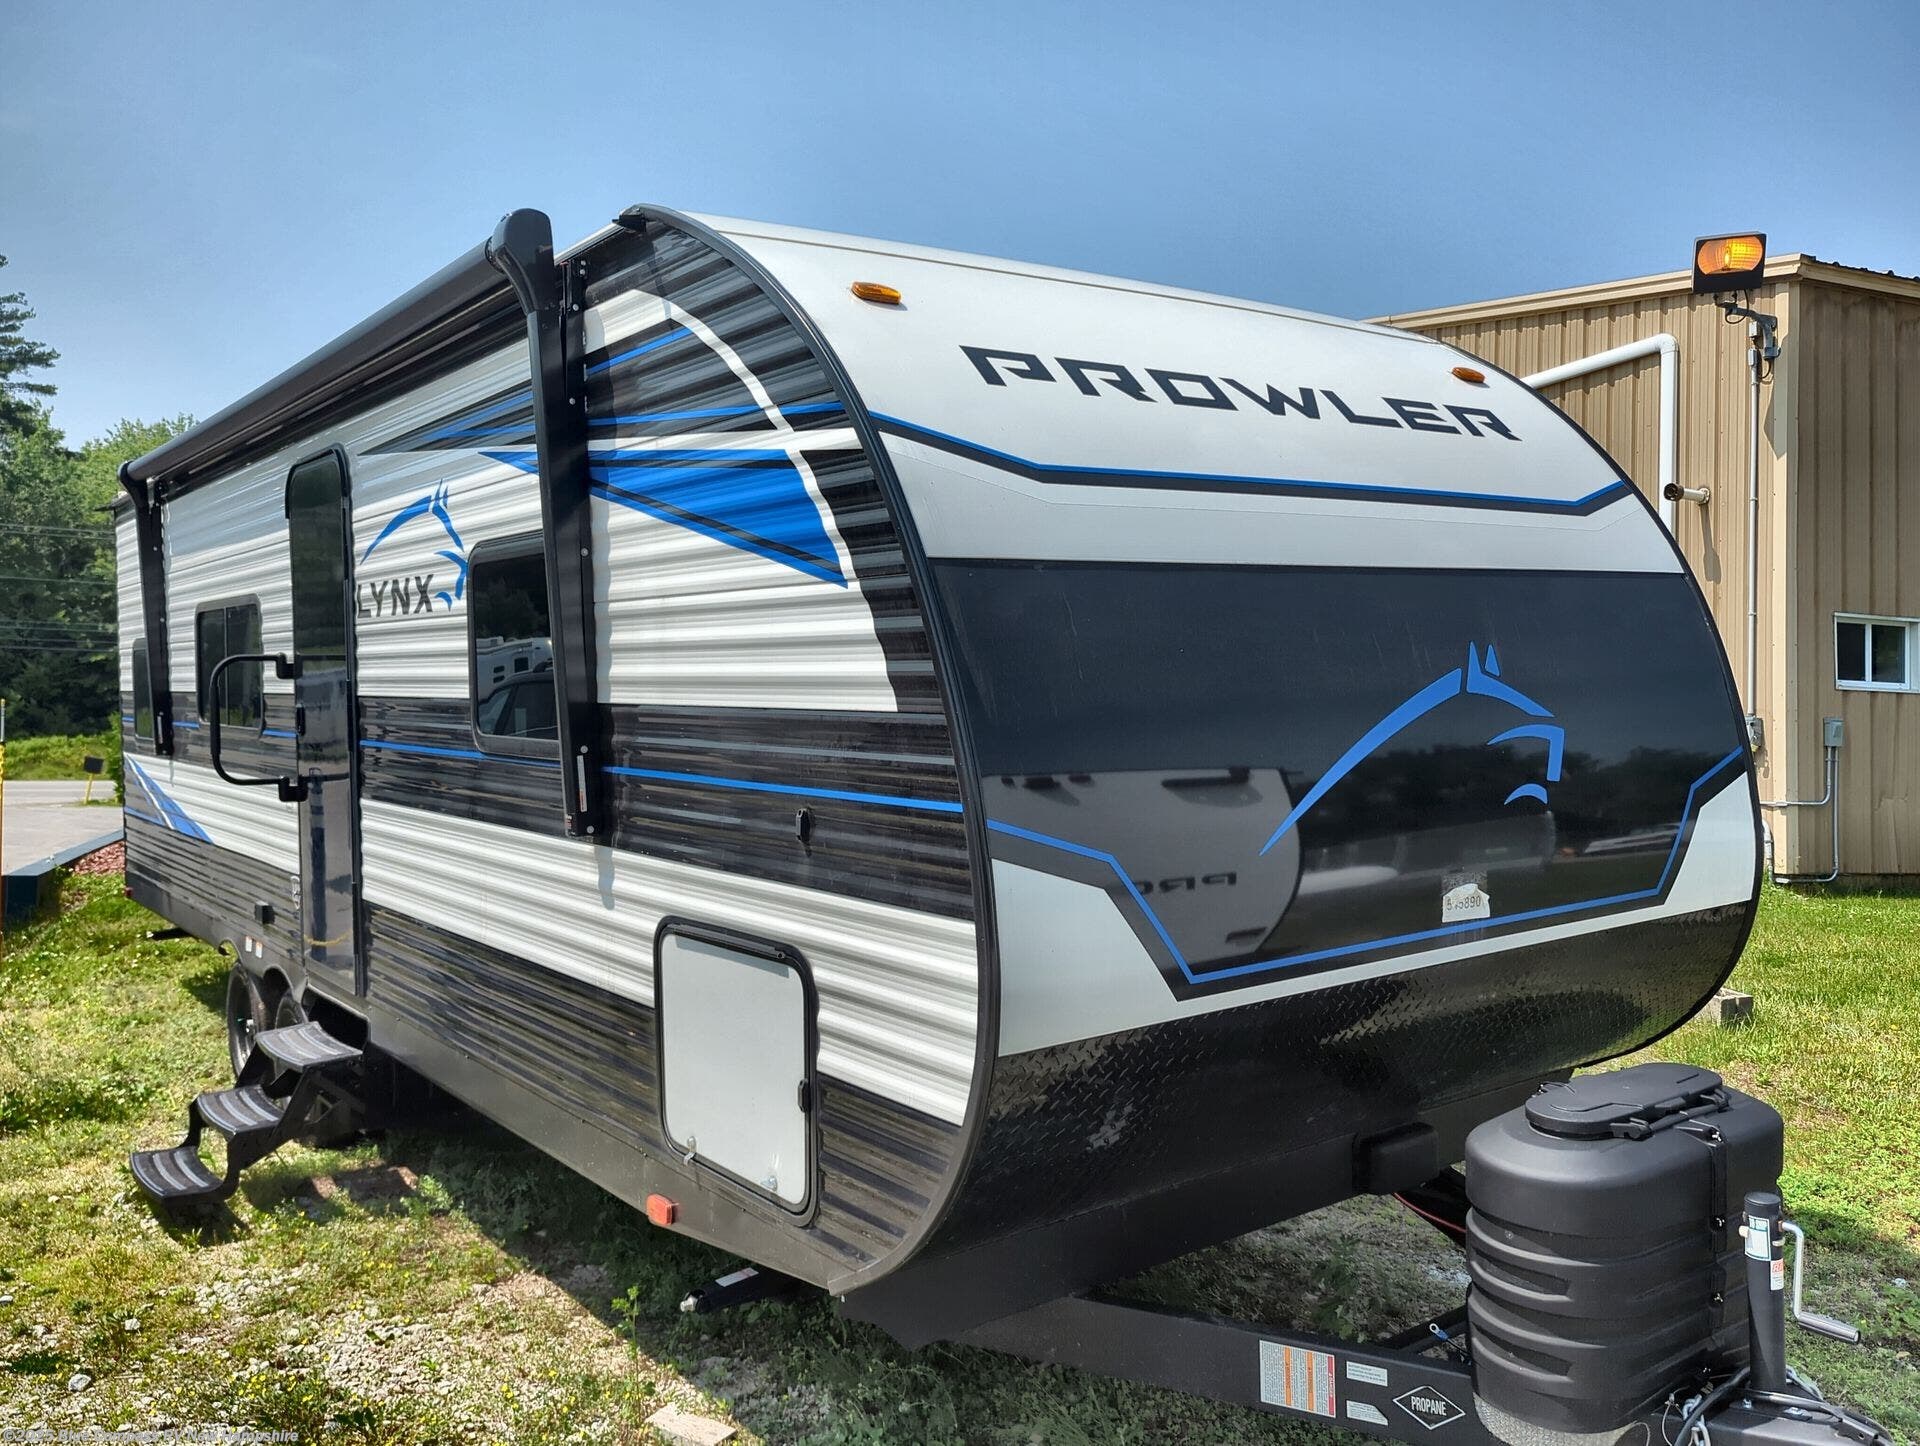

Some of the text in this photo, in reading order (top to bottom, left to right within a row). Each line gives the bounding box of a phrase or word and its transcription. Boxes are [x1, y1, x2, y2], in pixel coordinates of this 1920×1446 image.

[959, 345, 1522, 441] PROWLER
[357, 574, 434, 619] LYNX
[1410, 1395, 1447, 1416] PROPANE
